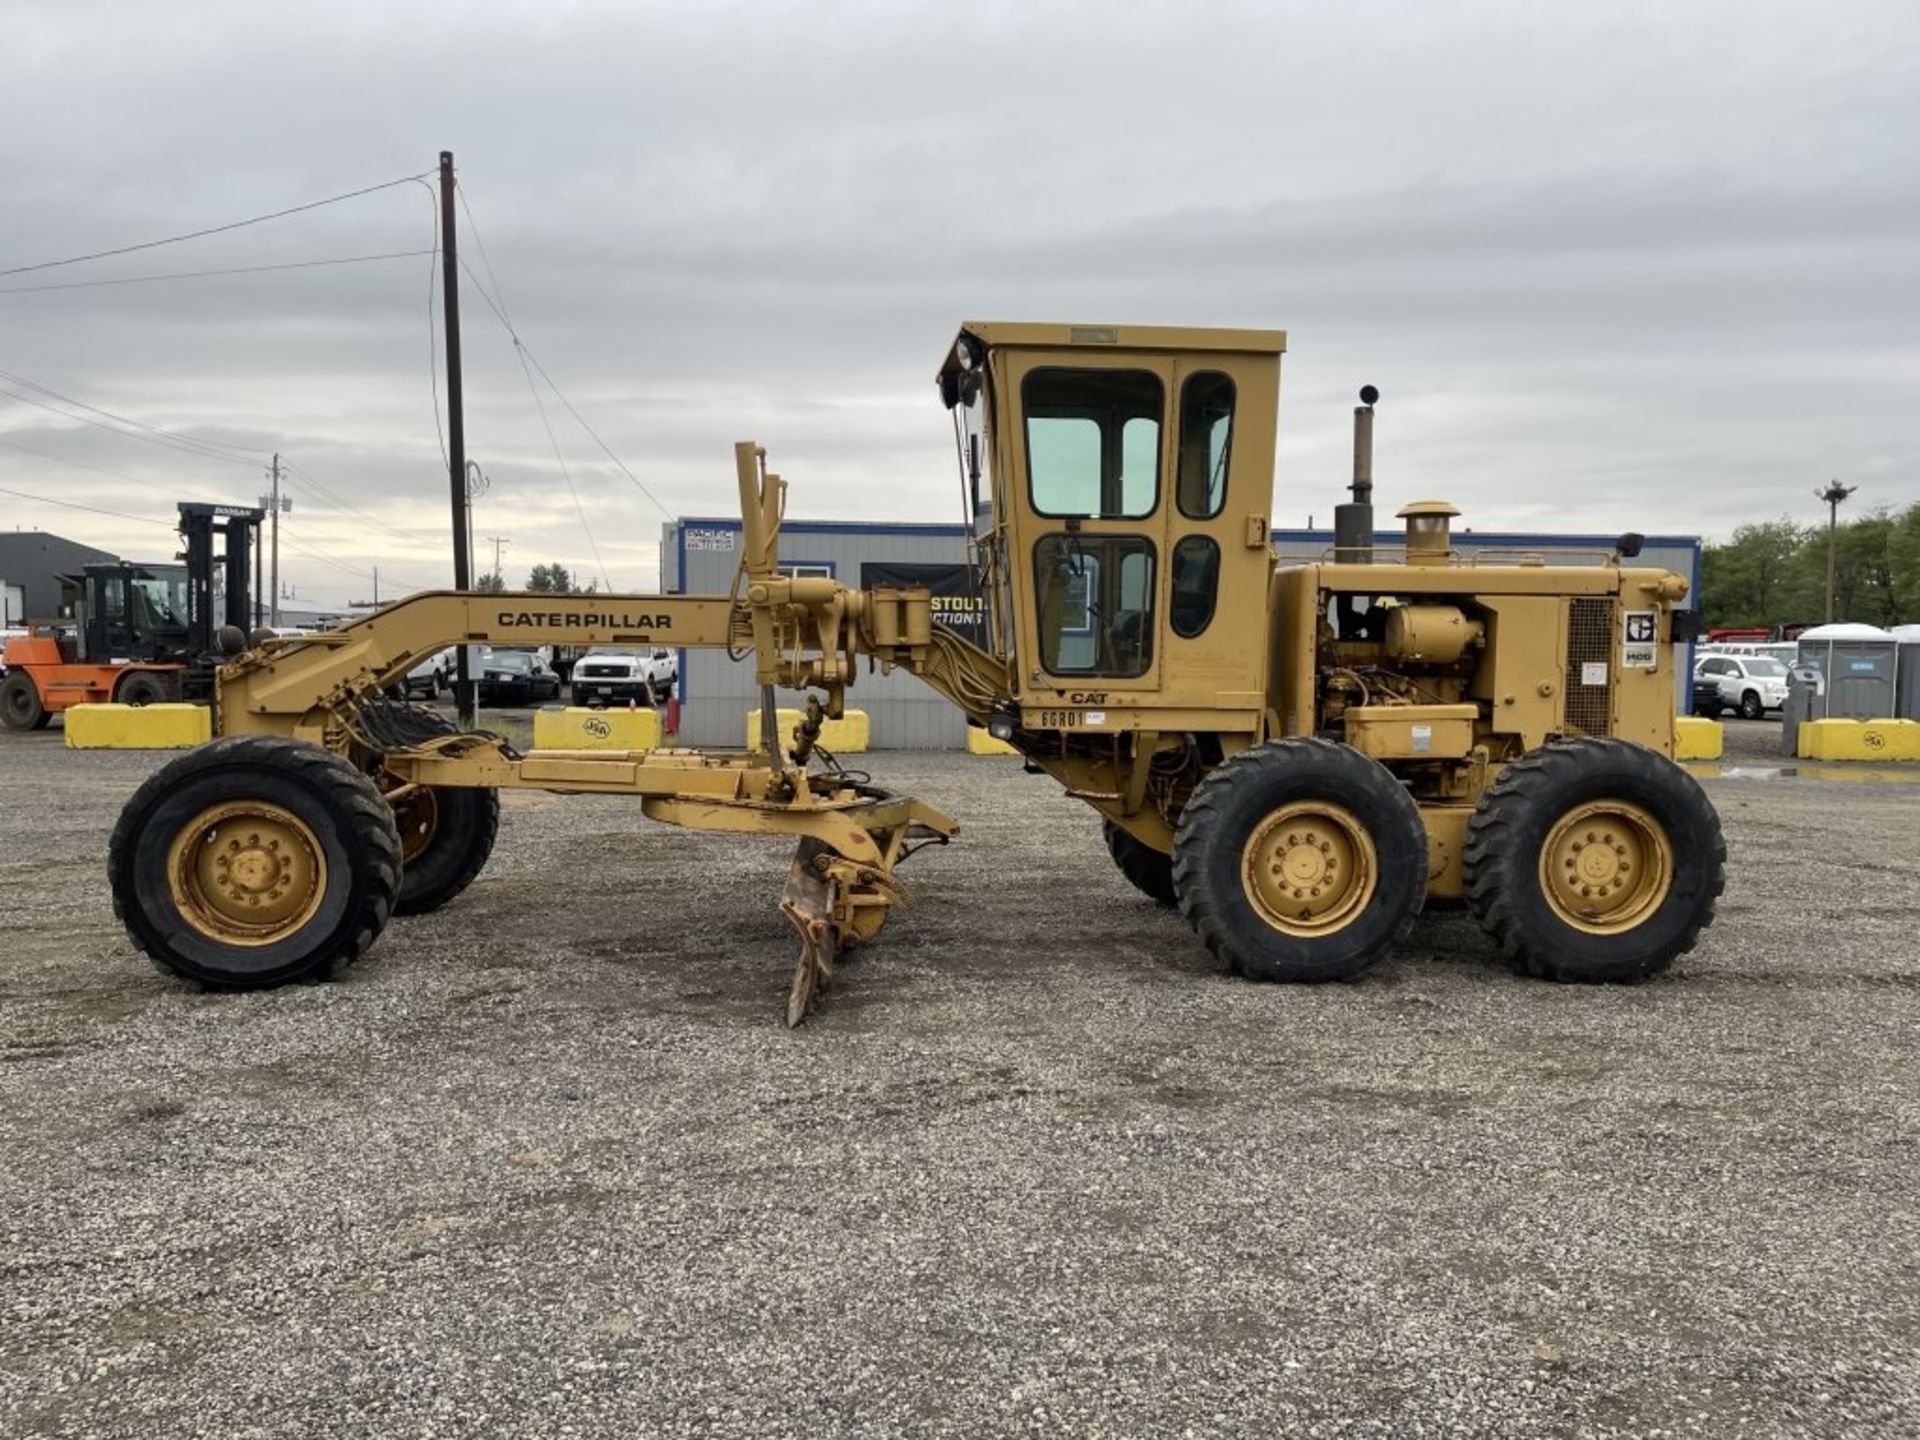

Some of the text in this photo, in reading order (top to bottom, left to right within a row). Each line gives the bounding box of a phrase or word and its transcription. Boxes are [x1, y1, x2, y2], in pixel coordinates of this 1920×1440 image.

[214, 506, 252, 517] DOOSAN
[497, 612, 673, 629] CATERPILLAR
[929, 612, 984, 625] CTIONS
[1071, 693, 1108, 705] CAT
